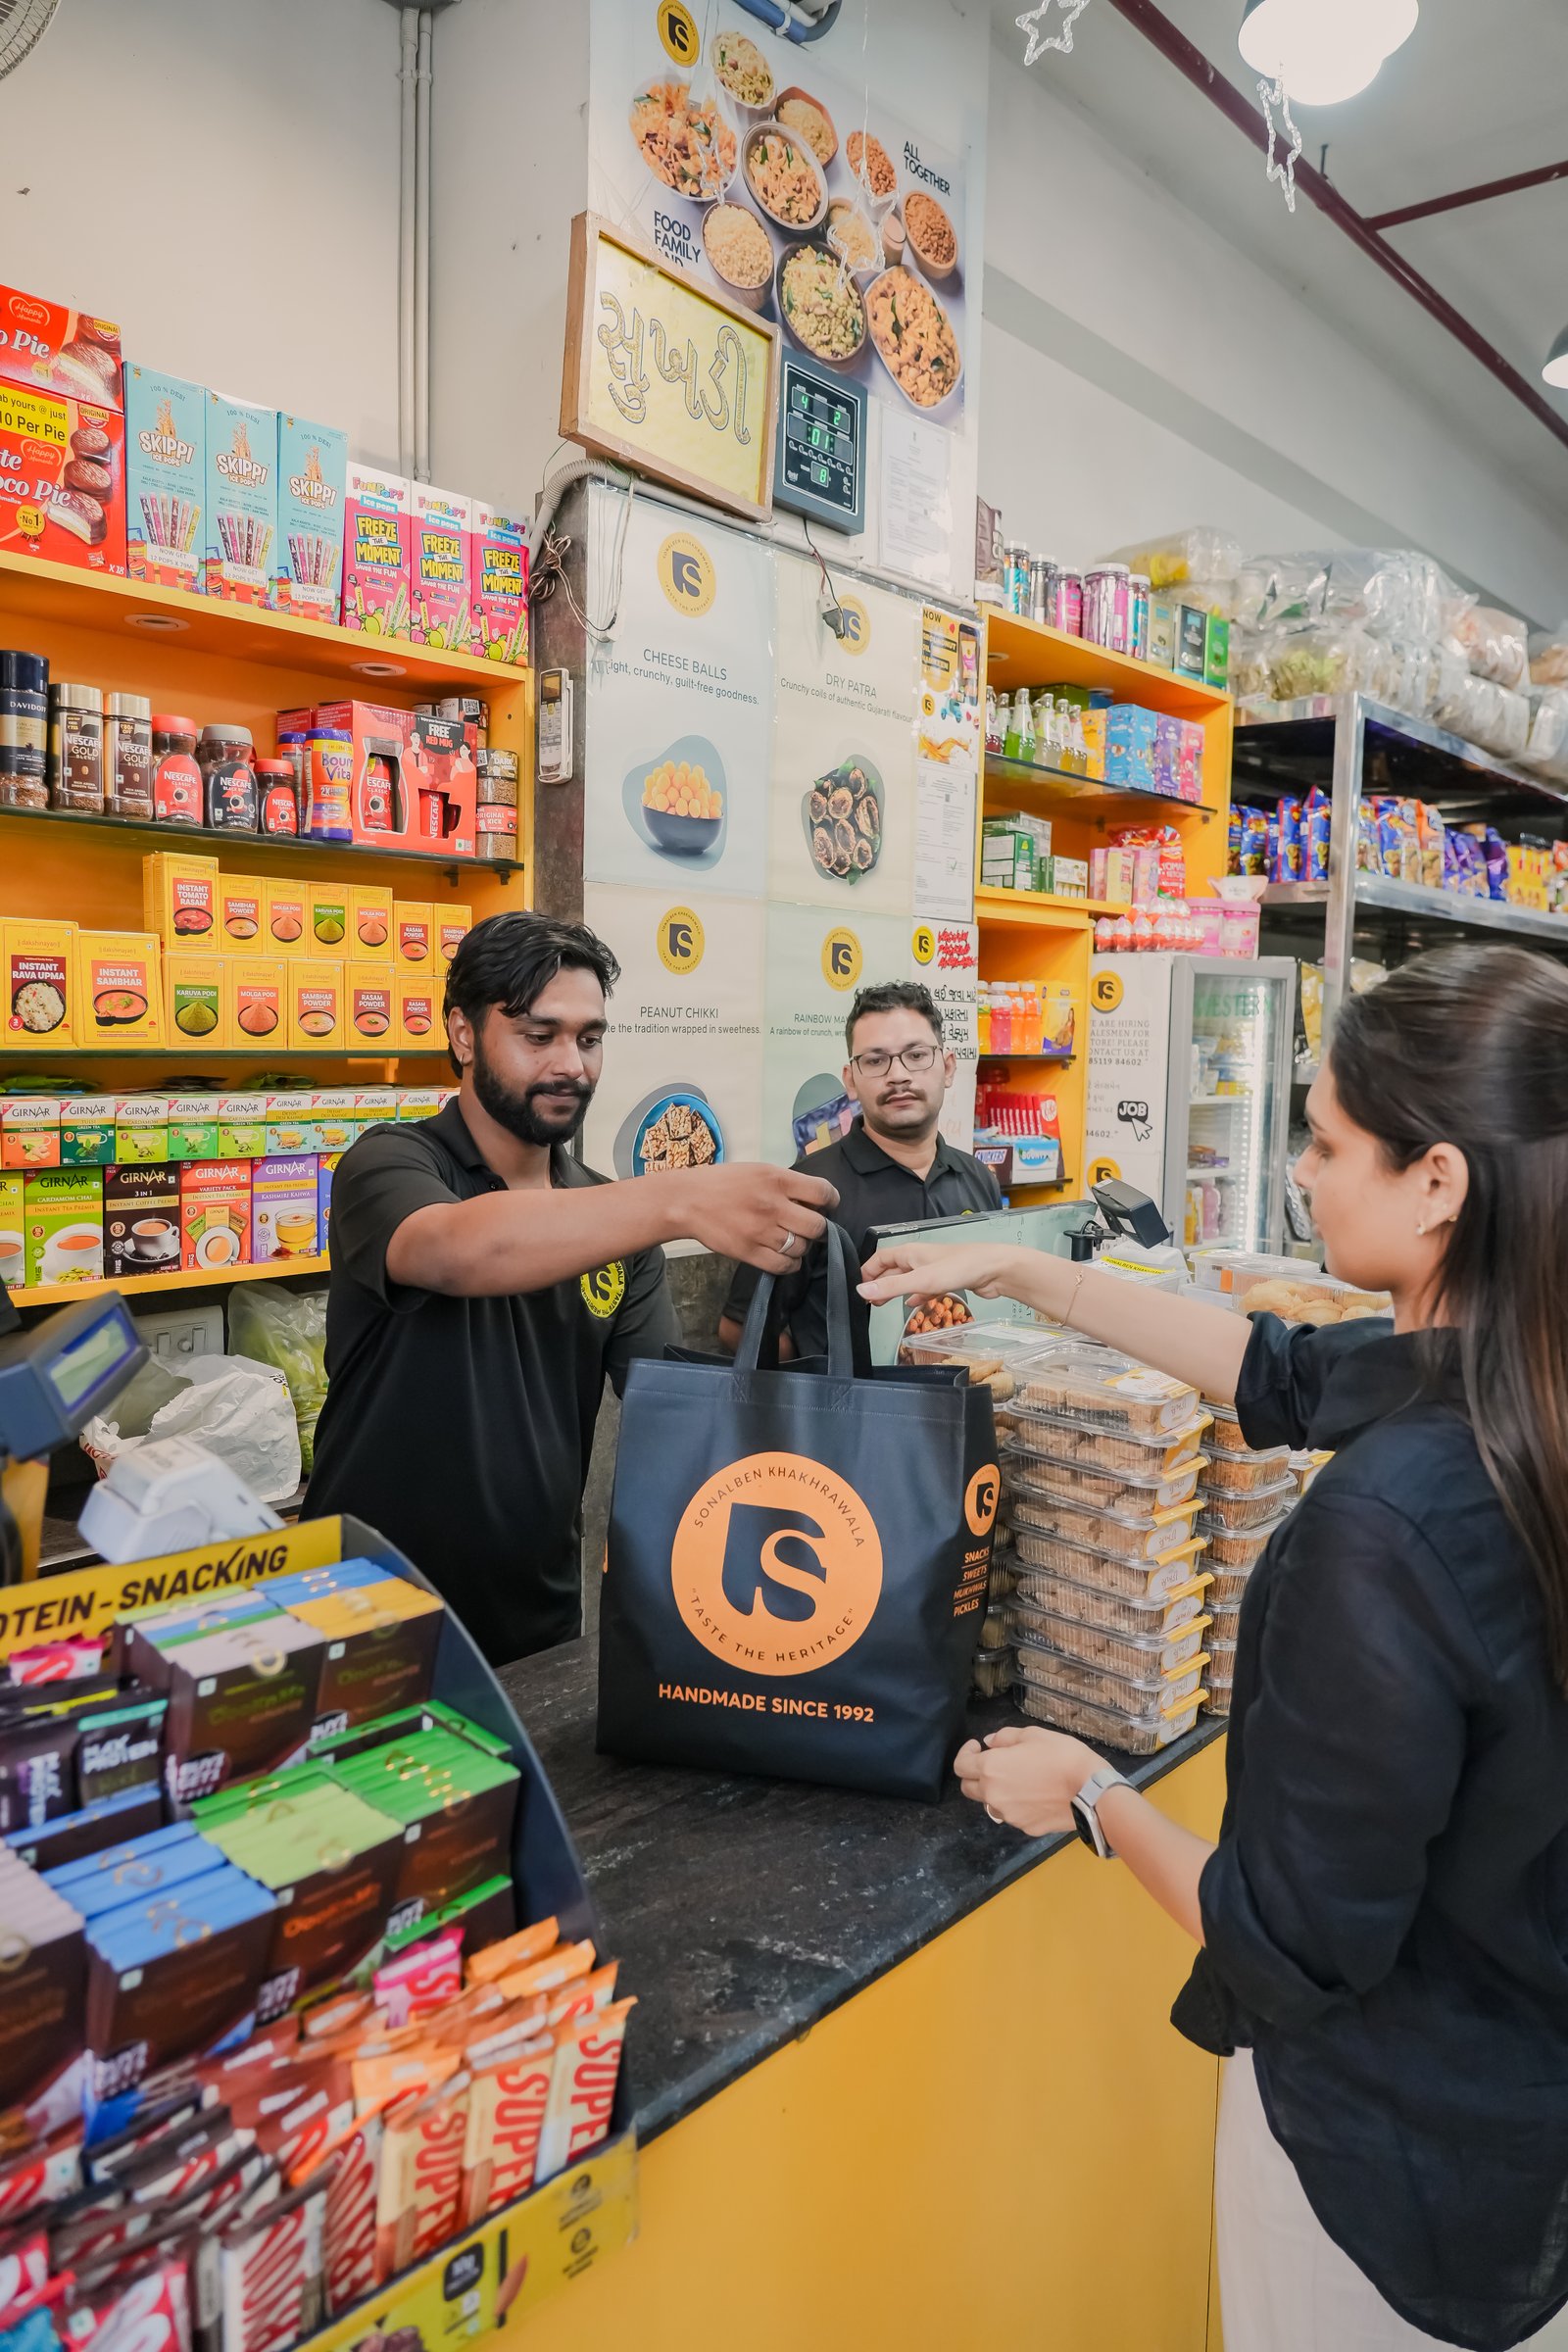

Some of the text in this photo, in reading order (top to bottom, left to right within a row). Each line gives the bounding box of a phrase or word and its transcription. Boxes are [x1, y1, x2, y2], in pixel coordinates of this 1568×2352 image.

[904, 141, 920, 162] ALL
[904, 155, 951, 196] TOGETHER
[654, 211, 691, 241] FOOD
[654, 229, 701, 264] FAMILY
[11, 329, 50, 359] Pie
[11, 399, 35, 412] yours
[50, 409, 66, 419] just
[79, 407, 108, 420] ORIGINAL
[833, 411, 841, 425] 2
[18, 416, 40, 434] Per
[44, 426, 66, 441] Pie
[26, 445, 56, 460] Happy
[139, 431, 195, 464] SKIPPI
[217, 454, 268, 484] SKIPPI
[819, 468, 827, 483] 8
[32, 479, 71, 506] Pie
[290, 476, 337, 506] SKIPPI
[357, 515, 397, 542] FREEZE
[356, 541, 402, 567] MOMENT
[422, 534, 461, 560] FREEZE
[483, 550, 520, 574] FREEZE
[383, 568, 397, 578] FUN
[420, 559, 464, 583] MOMENT
[482, 573, 523, 598] MOMENT
[922, 609, 942, 623] NOW
[643, 649, 727, 680] CHEESE BALLS
[608, 660, 760, 705] ight, crunchy, guilt-free goodness.
[826, 673, 877, 698] DRY PATRA
[780, 678, 809, 696] Crunchy
[810, 688, 827, 699] coils
[837, 696, 865, 710] authentic
[866, 704, 891, 717] Gujarati
[428, 723, 450, 738] FREE
[425, 736, 453, 748] RED MUG
[72, 746, 99, 757] GOLD
[123, 755, 149, 764] GOLD
[326, 766, 351, 781] Vita
[177, 884, 209, 893] INSTANT
[177, 891, 209, 900] TOMATO
[19, 962, 59, 971] INSTANT
[99, 968, 139, 977] INSTANT
[12, 971, 38, 980] RAVA
[640, 1006, 719, 1019] PEANUT CHIKKI
[794, 1013, 832, 1024] RAINBOW
[618, 1023, 632, 1033] the
[634, 1023, 669, 1034] tradition
[671, 1024, 708, 1036] wrapped
[709, 1024, 716, 1034] in
[717, 1025, 761, 1035] sweetness.
[810, 1028, 833, 1037] crunch,
[176, 1102, 210, 1113] GIRNAR
[226, 1102, 259, 1113] GIRNAR
[322, 1097, 345, 1106] GIRNAR
[409, 1096, 430, 1104] GIRNAR
[12, 1105, 50, 1118] GIRNAR
[70, 1104, 106, 1117] GIRNAR
[125, 1105, 161, 1117] GIRNAR
[1118, 1102, 1148, 1117] JOB
[195, 1165, 239, 1180] GIRNAR
[266, 1161, 307, 1176] GIRNAR
[40, 1174, 88, 1189] GIRNAR
[121, 1169, 167, 1185] GIRNAR
[694, 1466, 865, 1547] SONALBEN KHAKHRAWALA
[964, 1546, 990, 1563] SNACKS
[962, 1564, 988, 1582] SWEETS
[954, 1598, 979, 1617] PICKLES
[735, 1643, 765, 1661] THE
[659, 1684, 874, 1723] HANDMADE SINCE 1992
